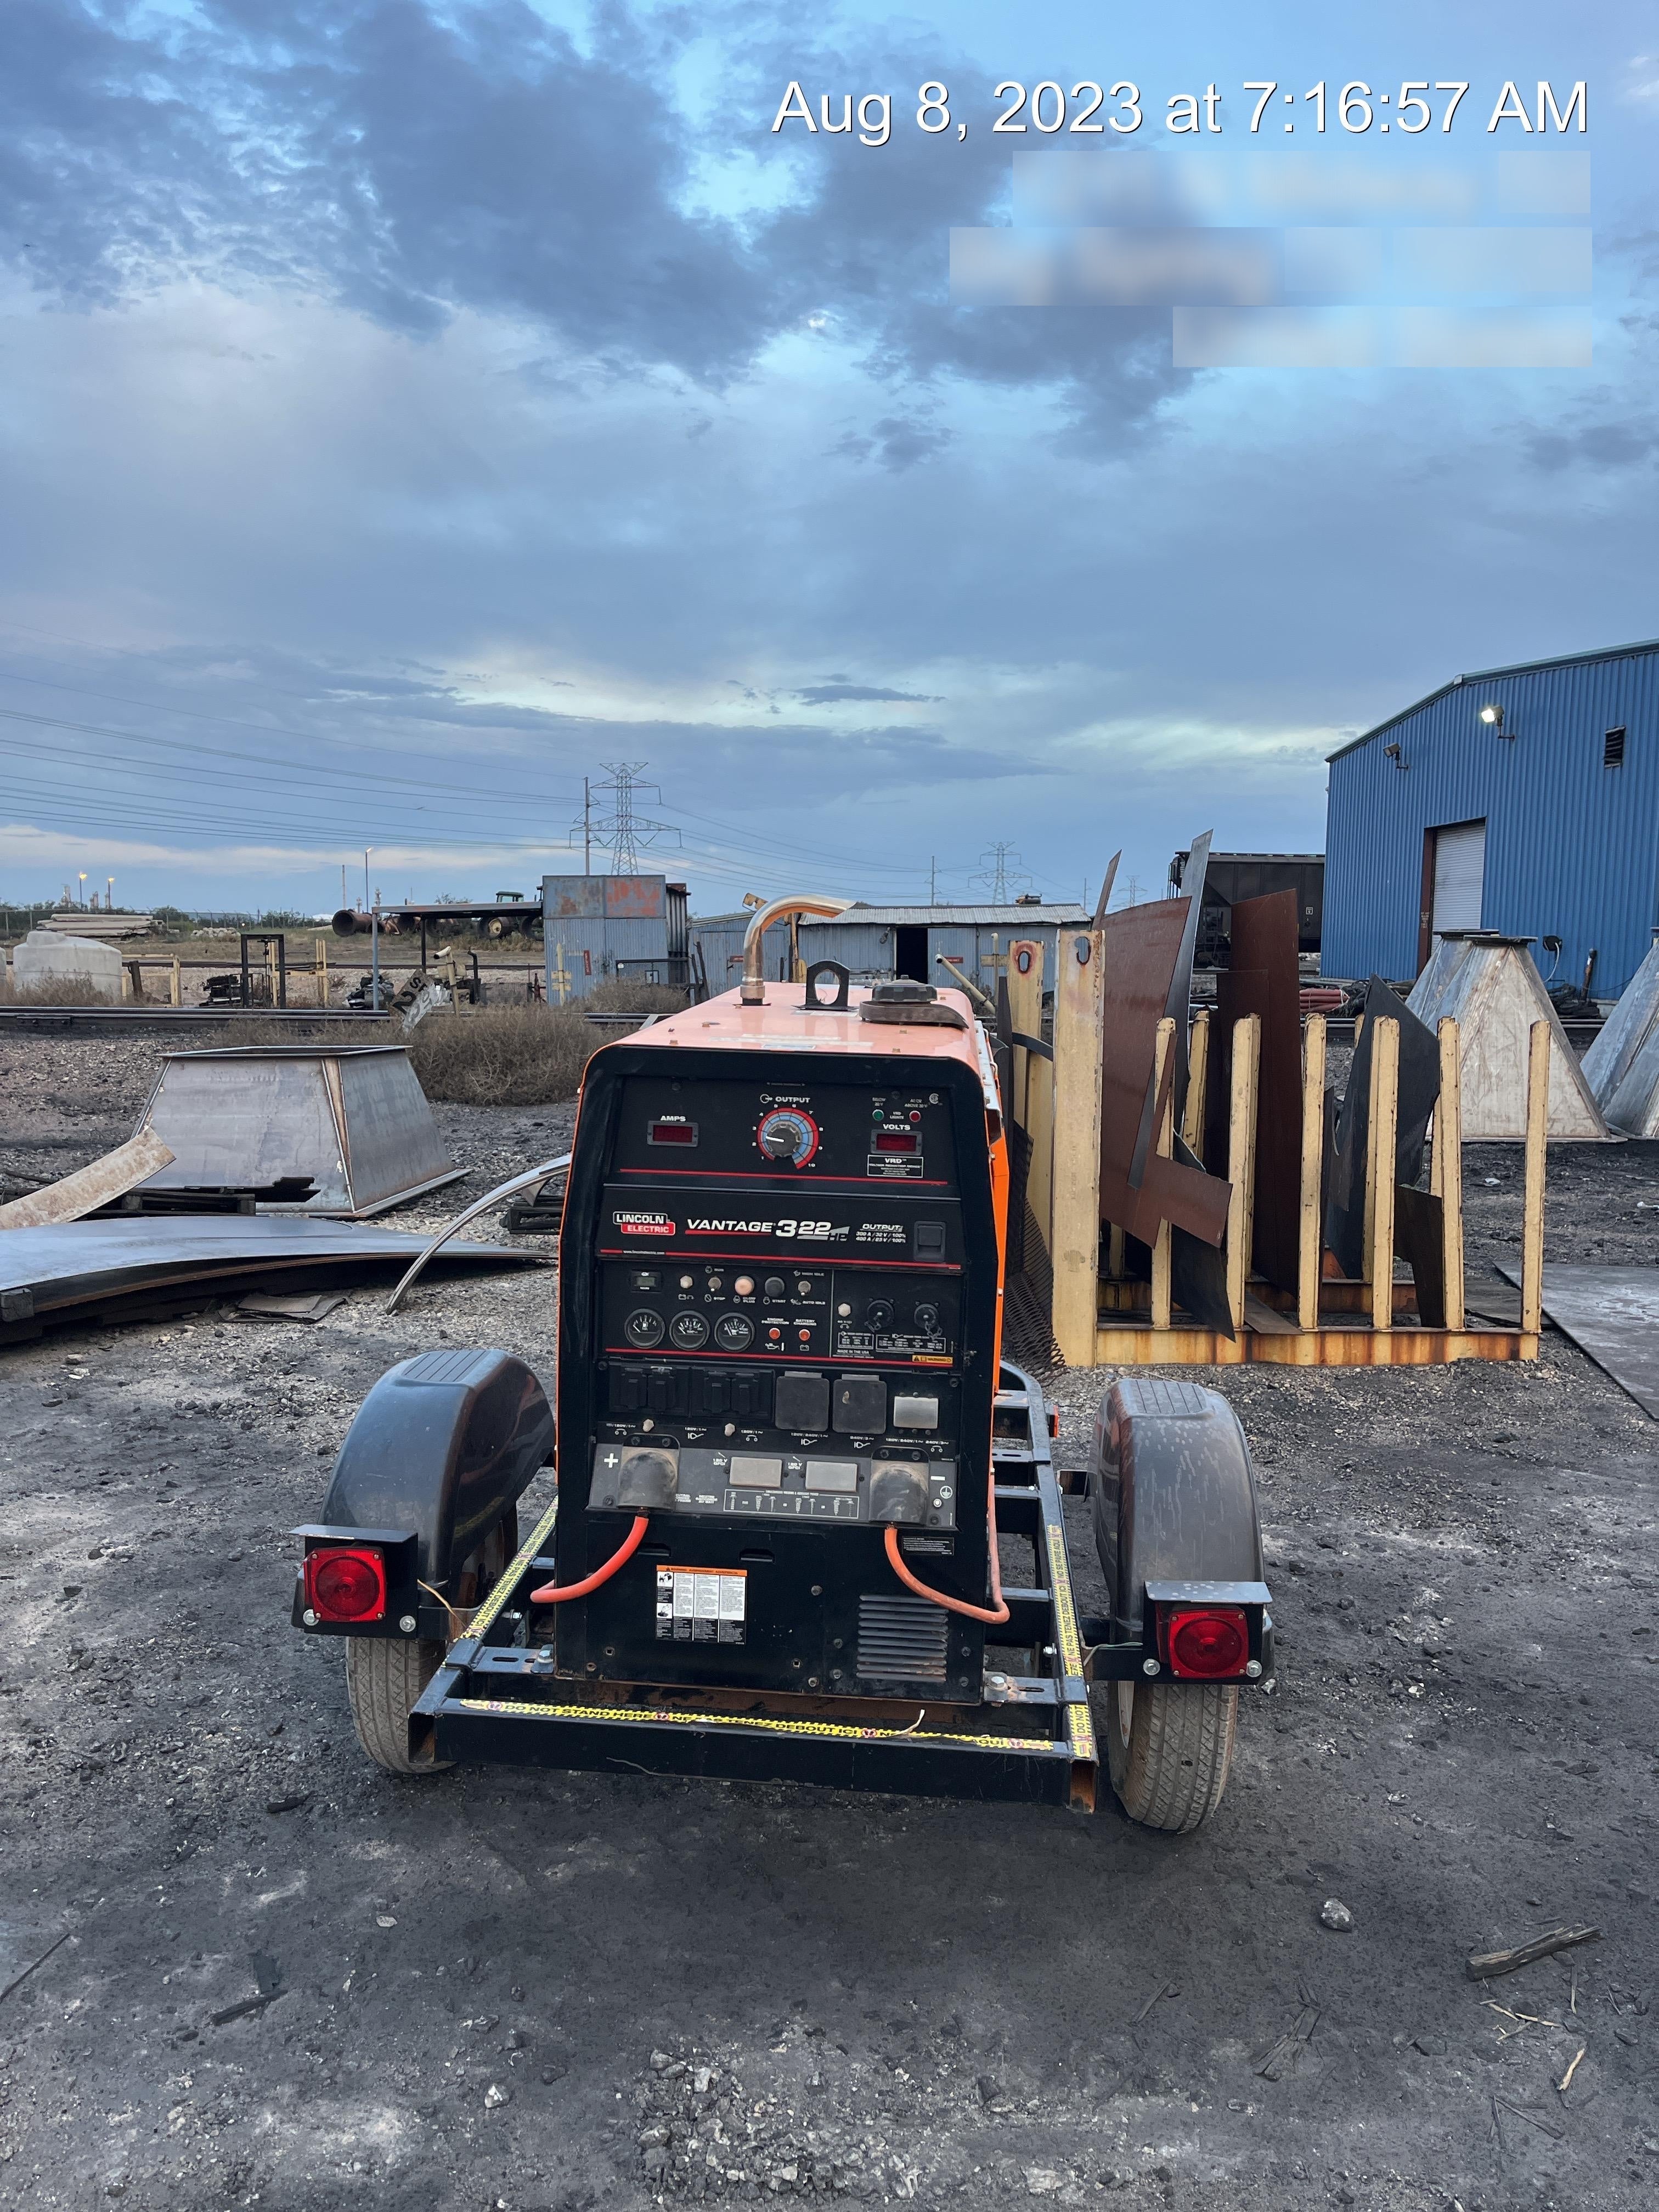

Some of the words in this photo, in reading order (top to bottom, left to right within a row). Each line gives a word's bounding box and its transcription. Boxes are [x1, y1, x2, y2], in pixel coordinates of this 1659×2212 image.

[616, 1214, 664, 1224] LINCOLN
[627, 1225, 669, 1233] ELECTRIC
[687, 1218, 774, 1232] VANTAGE
[775, 1220, 832, 1237] 322
[1060, 1593, 1070, 1615] DEBOUT
[1063, 1616, 1072, 1634] TENEZ
[1066, 1634, 1074, 1647] PAS
[1067, 1647, 1075, 1656] NE
[1074, 1705, 1085, 1721] NOT
[776, 1723, 836, 1733] DEBOUT
[1076, 1722, 1086, 1733] DO
